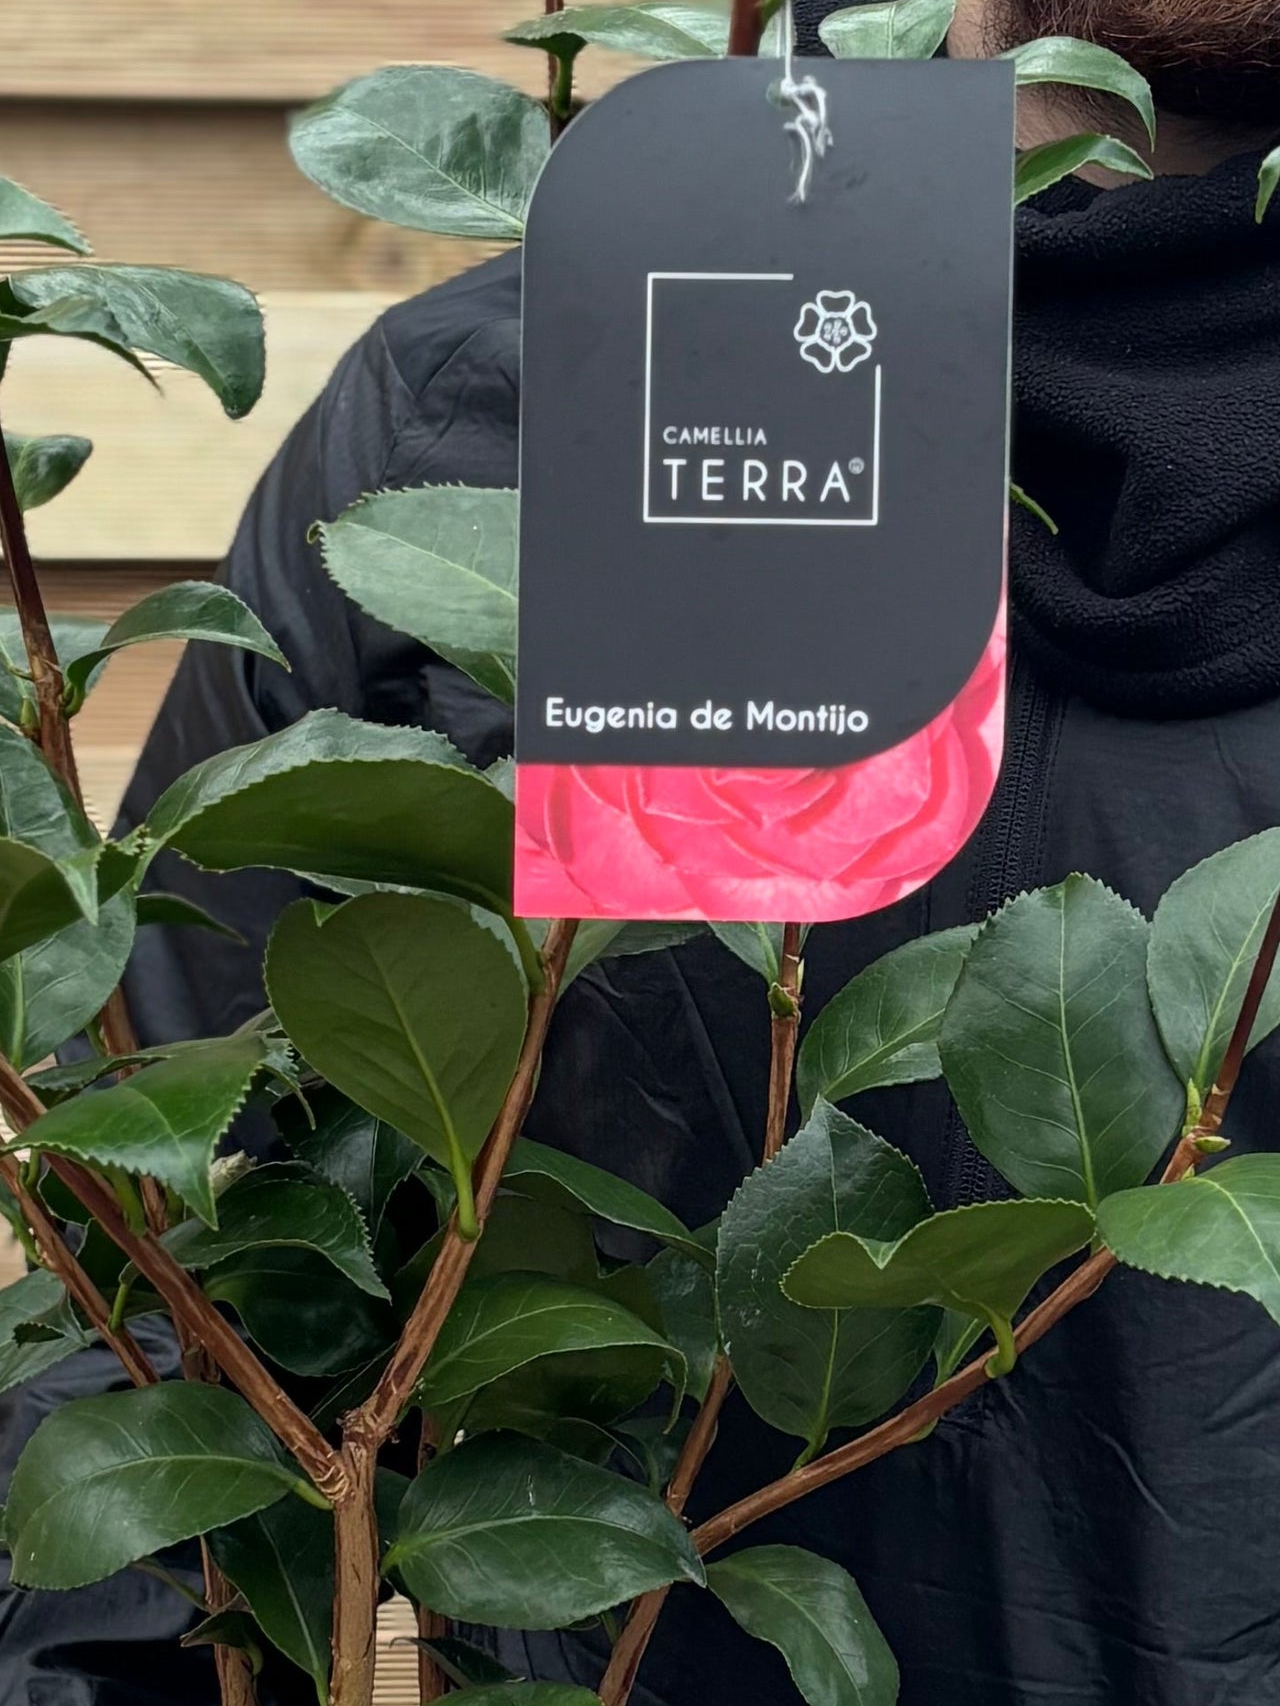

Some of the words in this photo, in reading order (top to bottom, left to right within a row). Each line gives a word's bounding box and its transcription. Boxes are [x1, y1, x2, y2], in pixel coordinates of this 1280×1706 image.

[662, 425, 768, 446] CAMELLIA
[545, 696, 678, 734] Eugenia
[689, 698, 734, 731] de
[746, 700, 870, 735] Montijo
